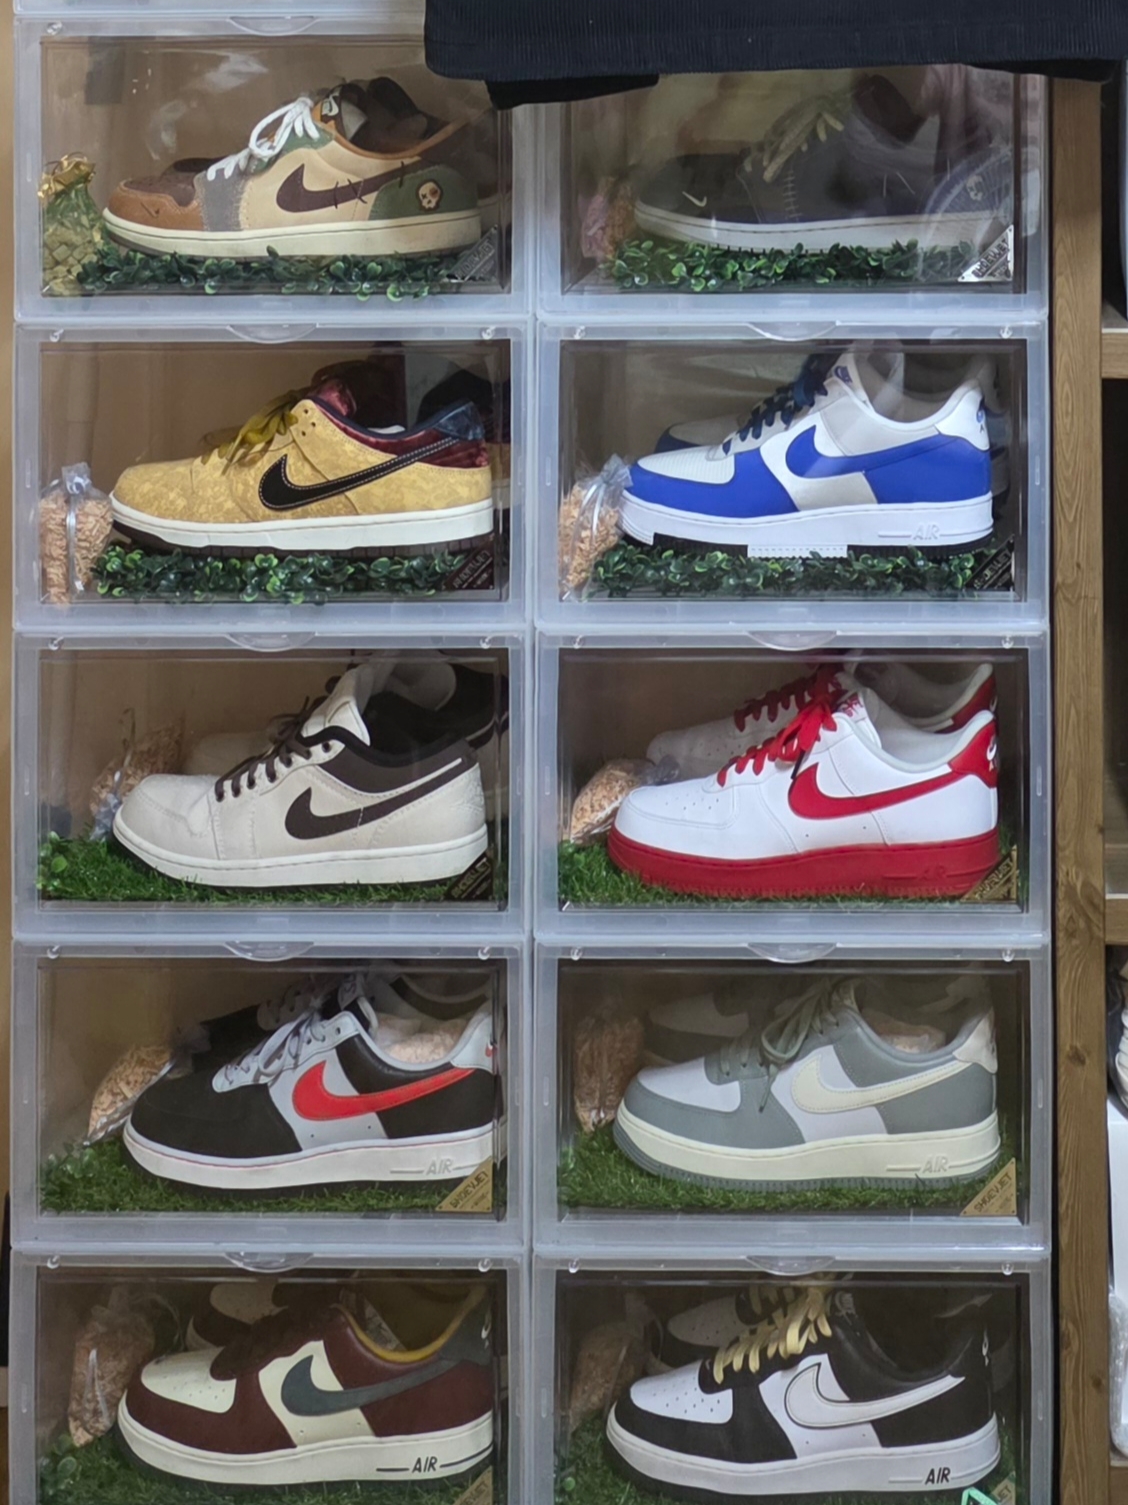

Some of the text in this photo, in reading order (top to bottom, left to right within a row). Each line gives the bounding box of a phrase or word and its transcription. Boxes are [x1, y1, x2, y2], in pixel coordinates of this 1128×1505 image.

[912, 524, 940, 540] AIR
[425, 1158, 453, 1176] AIR
[922, 1156, 949, 1173] AIR
[412, 1455, 438, 1474] AIR
[925, 1467, 951, 1485] AIR
